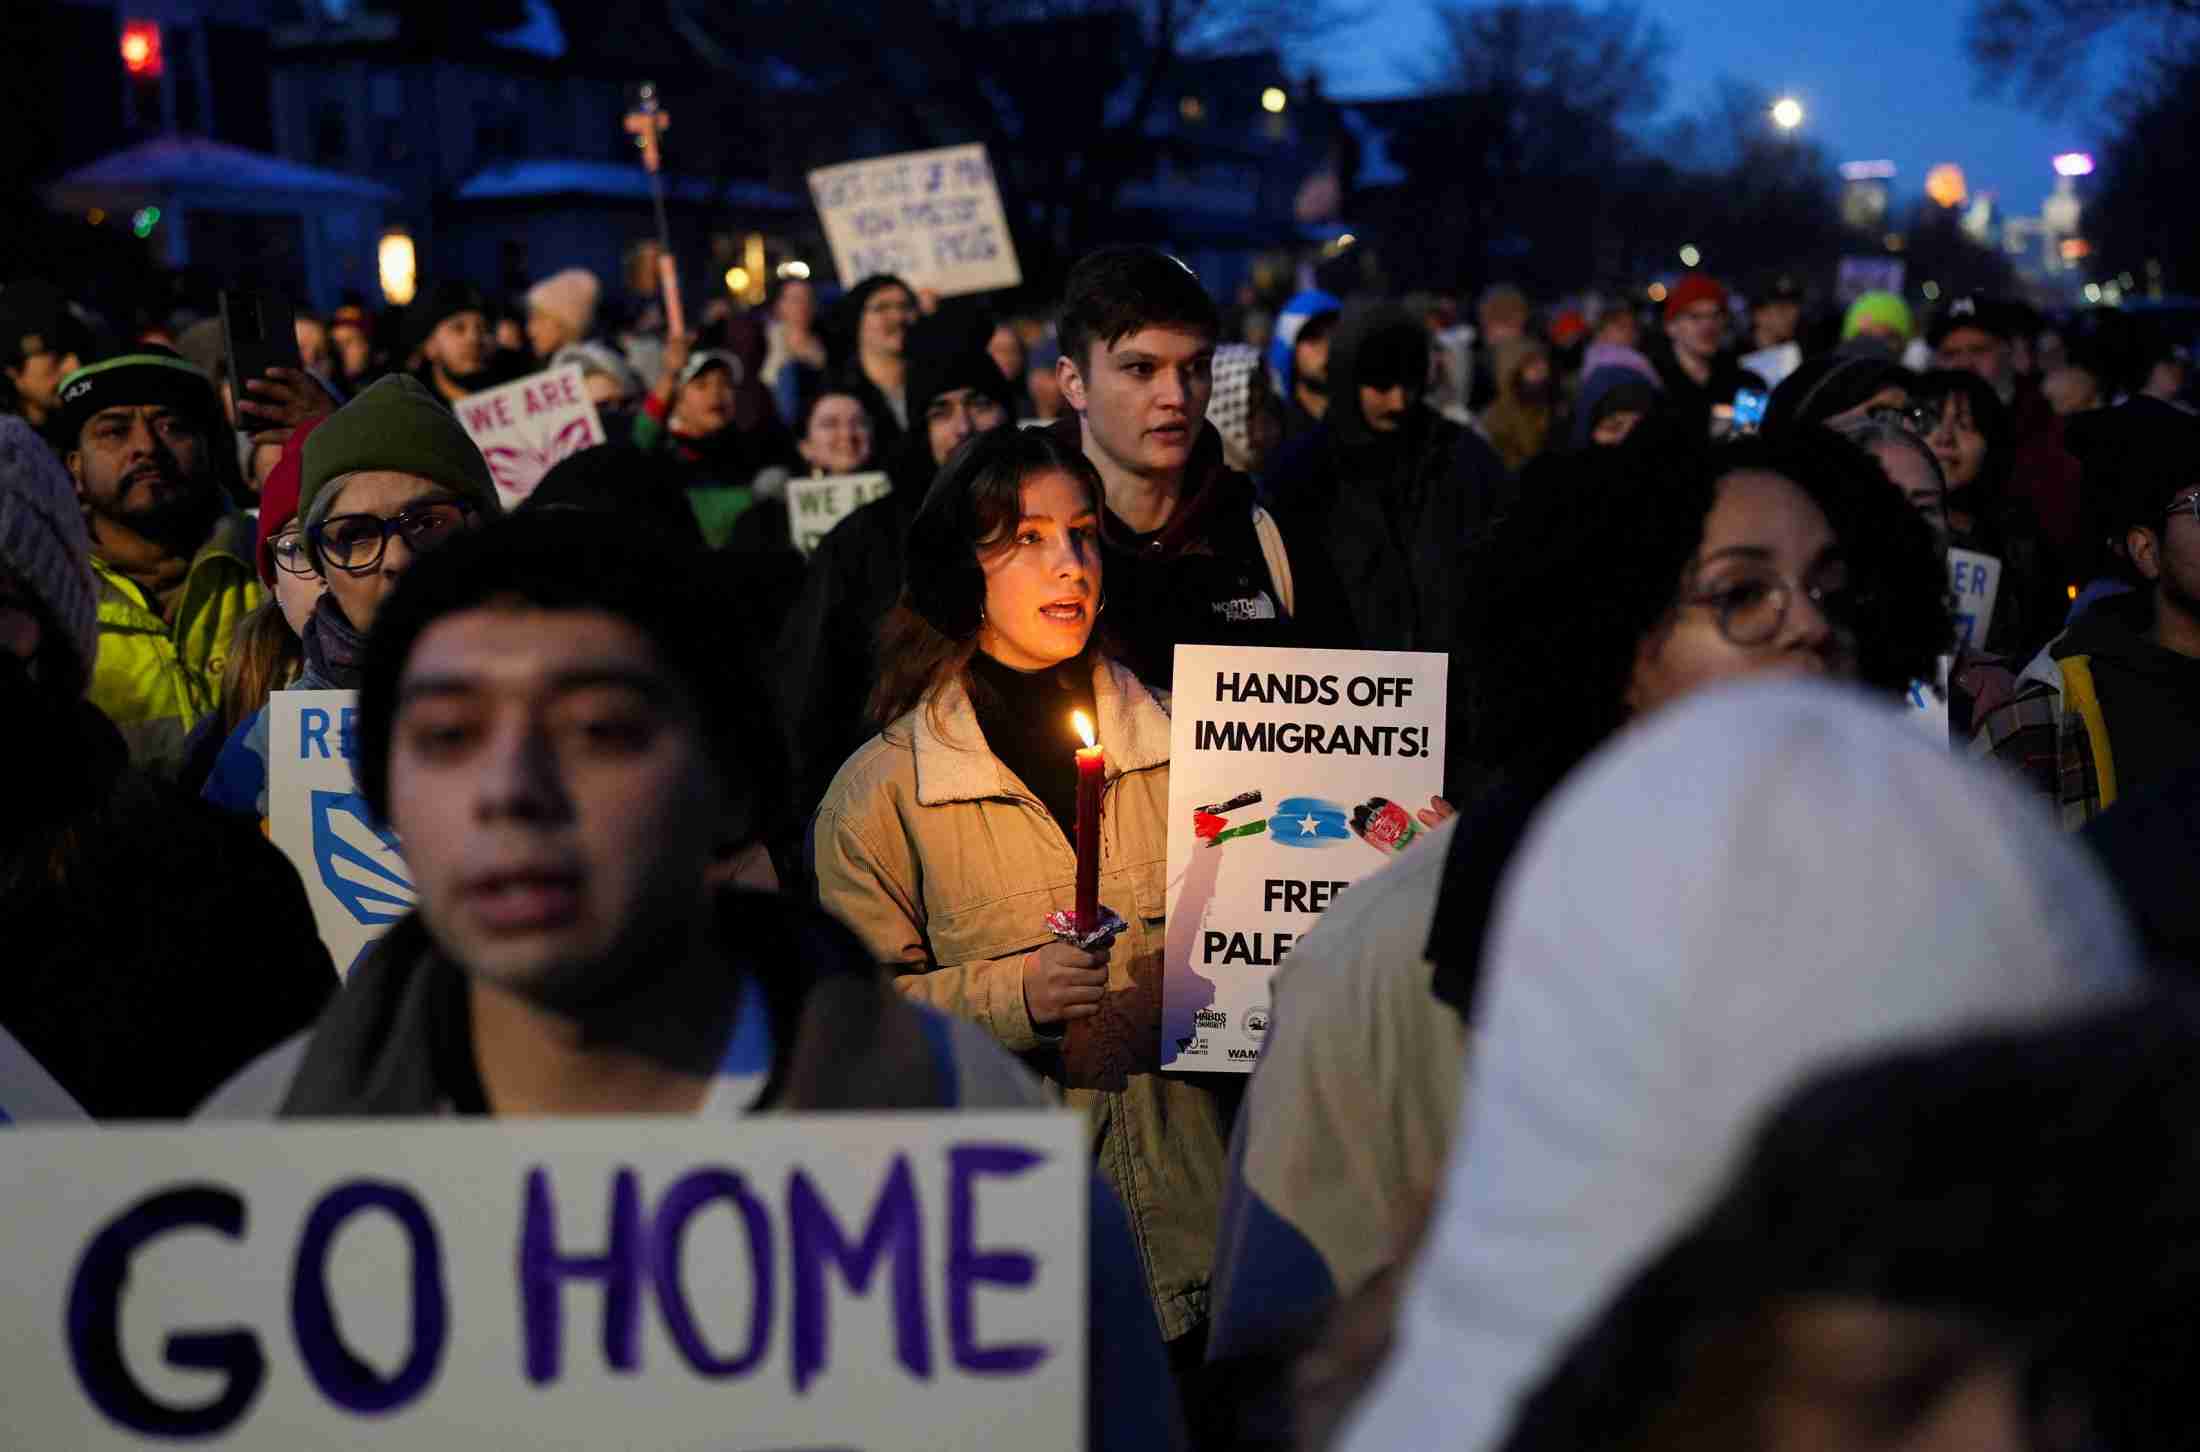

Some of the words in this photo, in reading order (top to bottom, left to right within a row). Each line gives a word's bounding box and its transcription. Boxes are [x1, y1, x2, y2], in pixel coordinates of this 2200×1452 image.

[465, 397, 513, 432] WE
[525, 375, 577, 414] ARE
[799, 487, 833, 514] WE
[1954, 560, 1987, 593] ER
[1216, 672, 1339, 705] HANDS
[1347, 676, 1413, 707] OFF
[1195, 720, 1429, 758] IMMIGRANTS!
[1203, 931, 1304, 966] PALE
[67, 1182, 450, 1441] GO
[519, 1142, 1050, 1397] HOME
